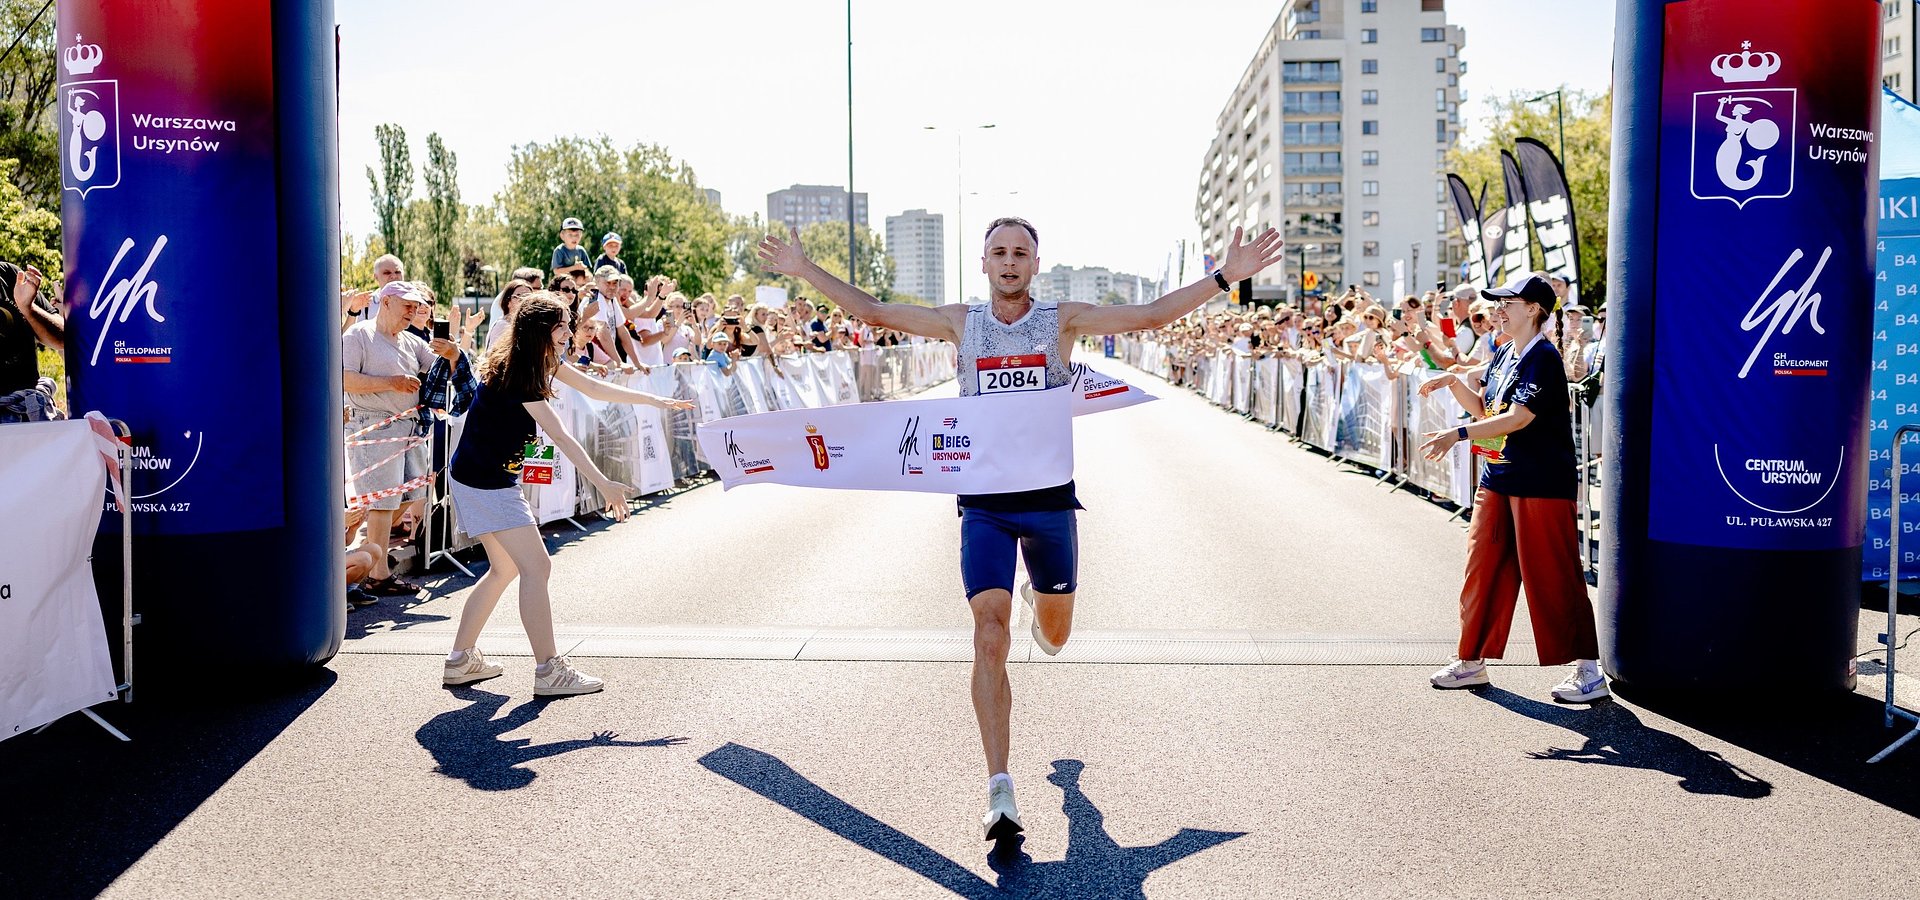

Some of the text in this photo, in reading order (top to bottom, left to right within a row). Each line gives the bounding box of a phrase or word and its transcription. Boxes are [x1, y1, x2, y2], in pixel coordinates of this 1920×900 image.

[132, 113, 236, 131] Warszawa
[1809, 123, 1874, 143] Warszawa
[133, 136, 220, 154] Ursynów
[1809, 145, 1868, 164] Ursynów
[1895, 254, 1917, 266] B4
[1896, 284, 1918, 296] B4
[1895, 314, 1919, 326] B4
[114, 347, 172, 355] DEVELOPMENT
[1896, 343, 1919, 355] B4
[986, 370, 1038, 389] 2084
[1895, 373, 1918, 385] B4
[1896, 403, 1918, 415] B4
[946, 436, 971, 448] BIEG
[932, 452, 971, 461] URSYNOWA
[1869, 449, 1891, 460] B4
[1745, 459, 1805, 472] CENTRUM
[1900, 463, 1920, 474] B4
[1762, 469, 1822, 484] URSYNÓW
[1869, 479, 1892, 490] B4
[1900, 493, 1920, 504] B4
[106, 503, 167, 512] PUWSKA
[170, 503, 190, 512] 427
[1871, 508, 1891, 519] B4
[1726, 516, 1832, 528] UL. PUŁAWSKA 427
